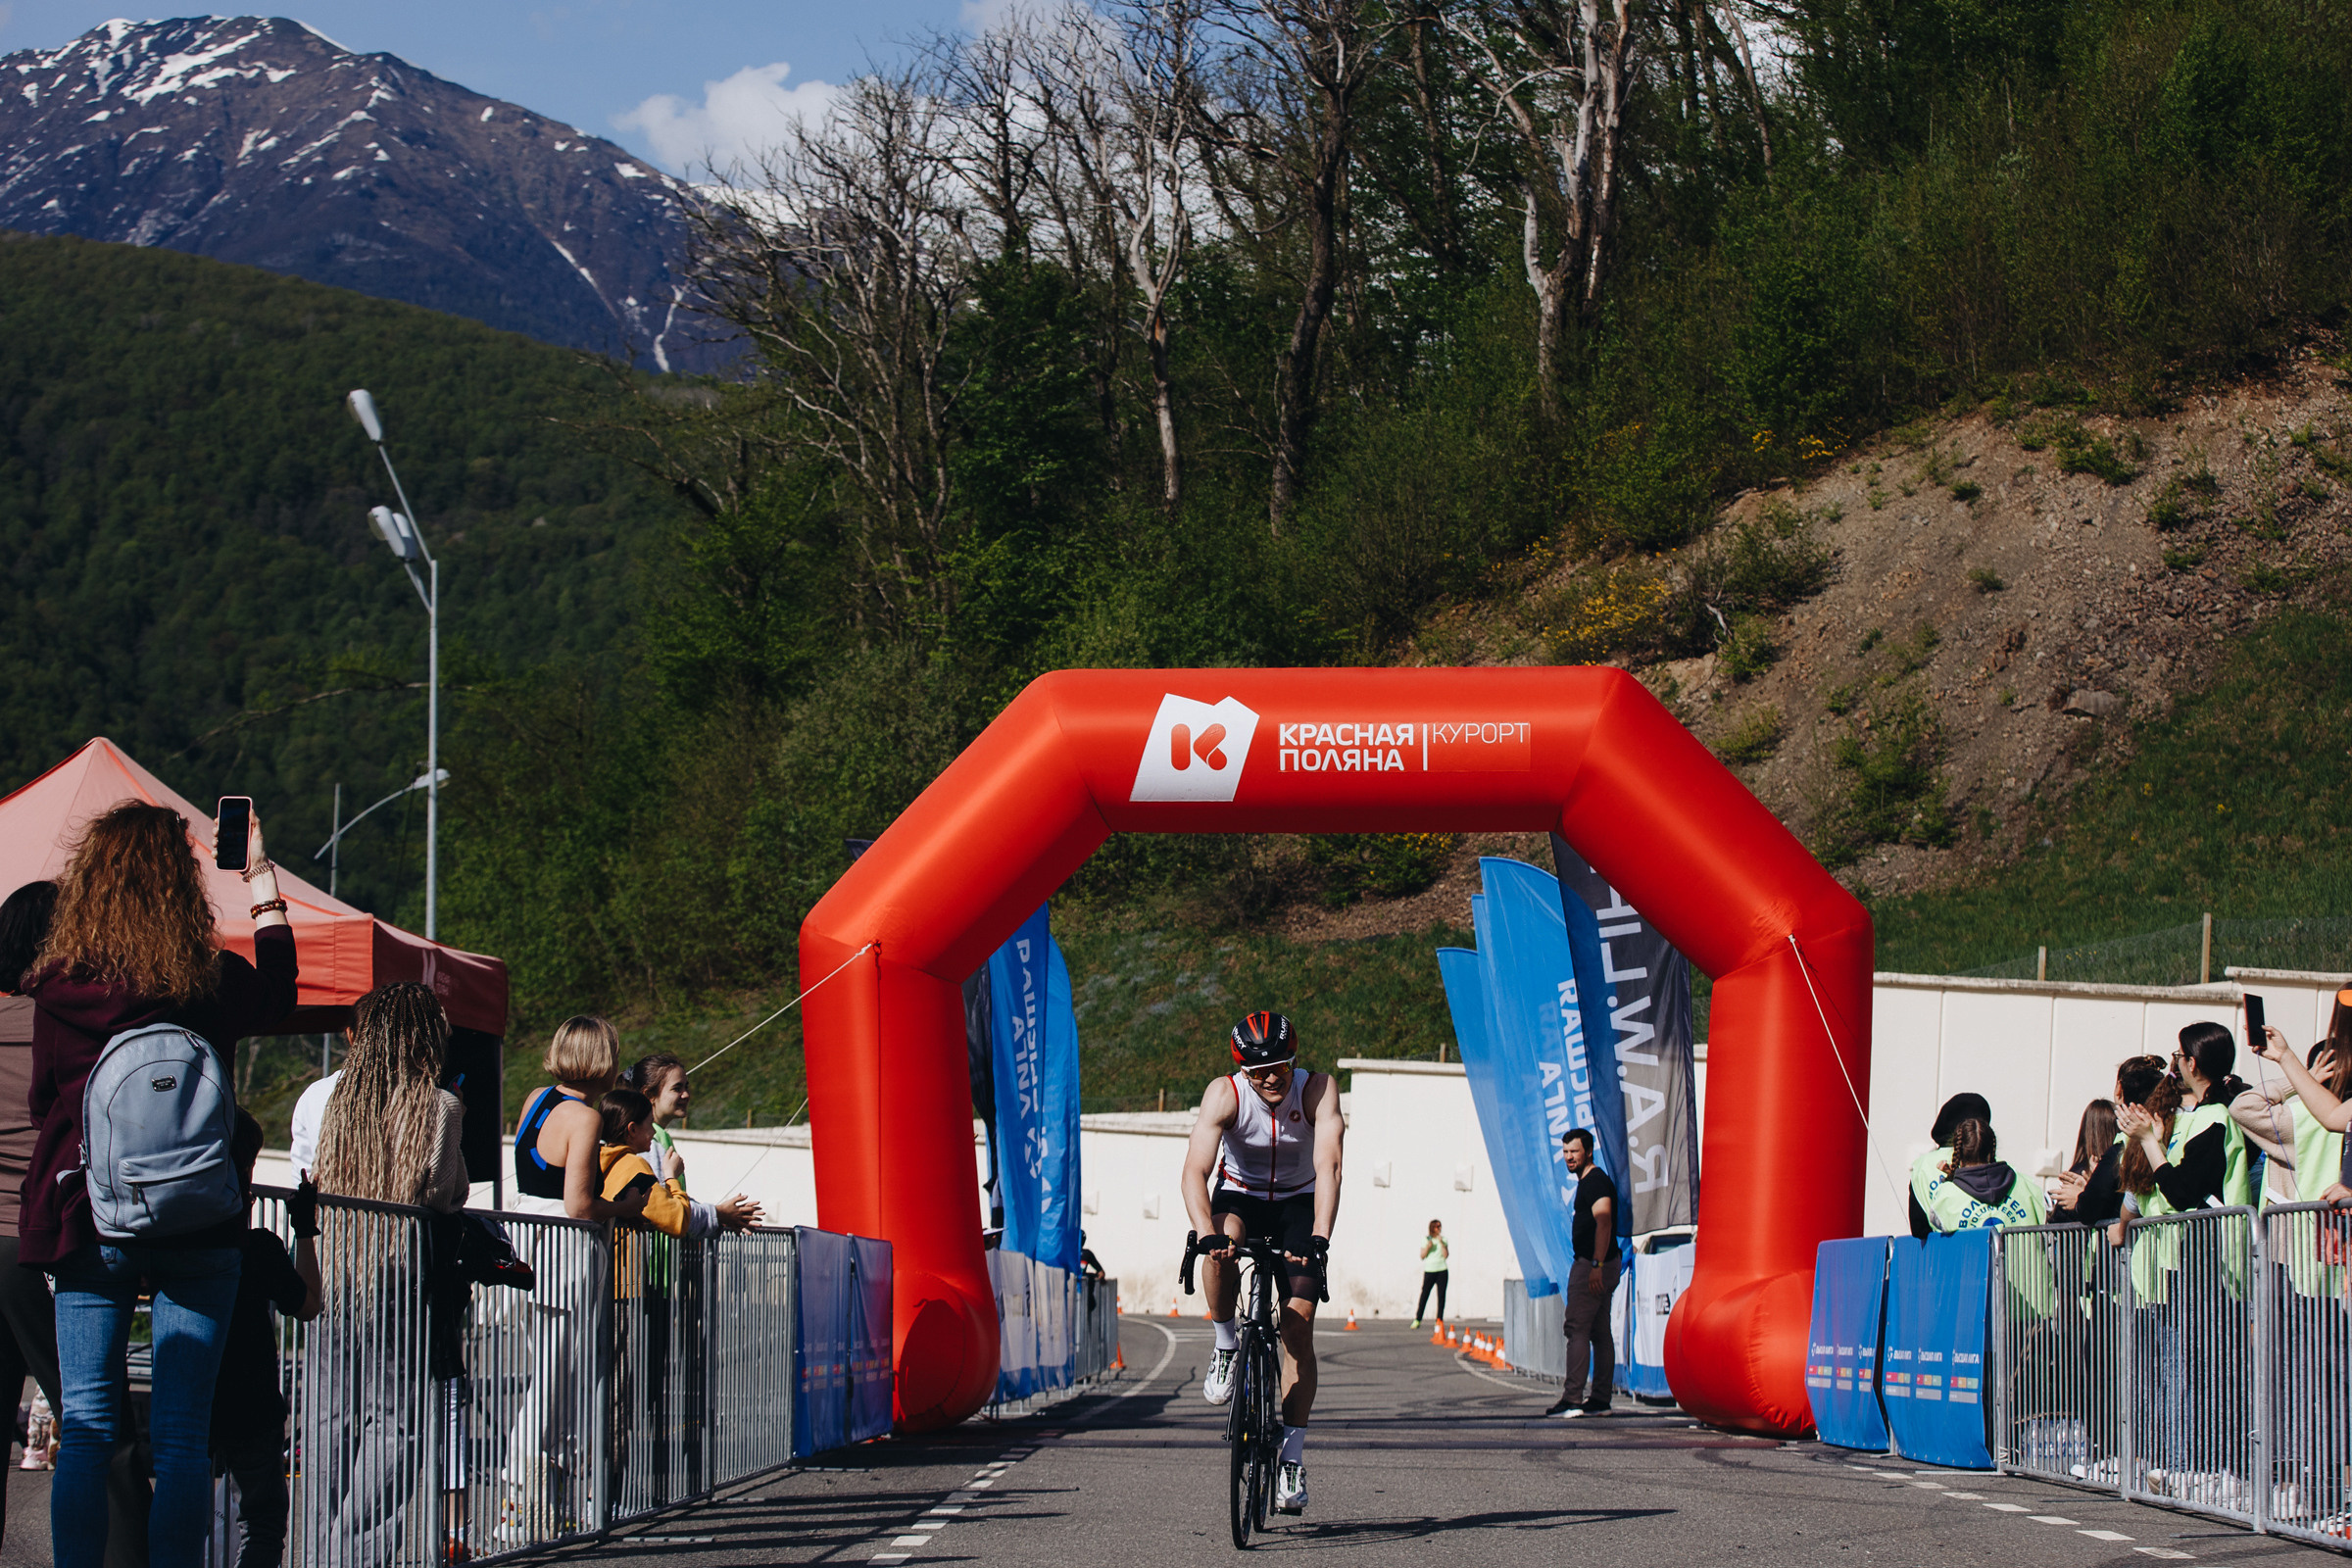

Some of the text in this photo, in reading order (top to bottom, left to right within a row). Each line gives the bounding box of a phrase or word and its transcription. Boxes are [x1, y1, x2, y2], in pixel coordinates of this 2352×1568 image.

[1279, 723, 1414, 746] КРАСНАЯ
[1433, 722, 1529, 744] КУРОРТ
[1279, 749, 1405, 771] ПОЛЯНА
[1959, 1196, 2027, 1228] ВОЛТЕР
